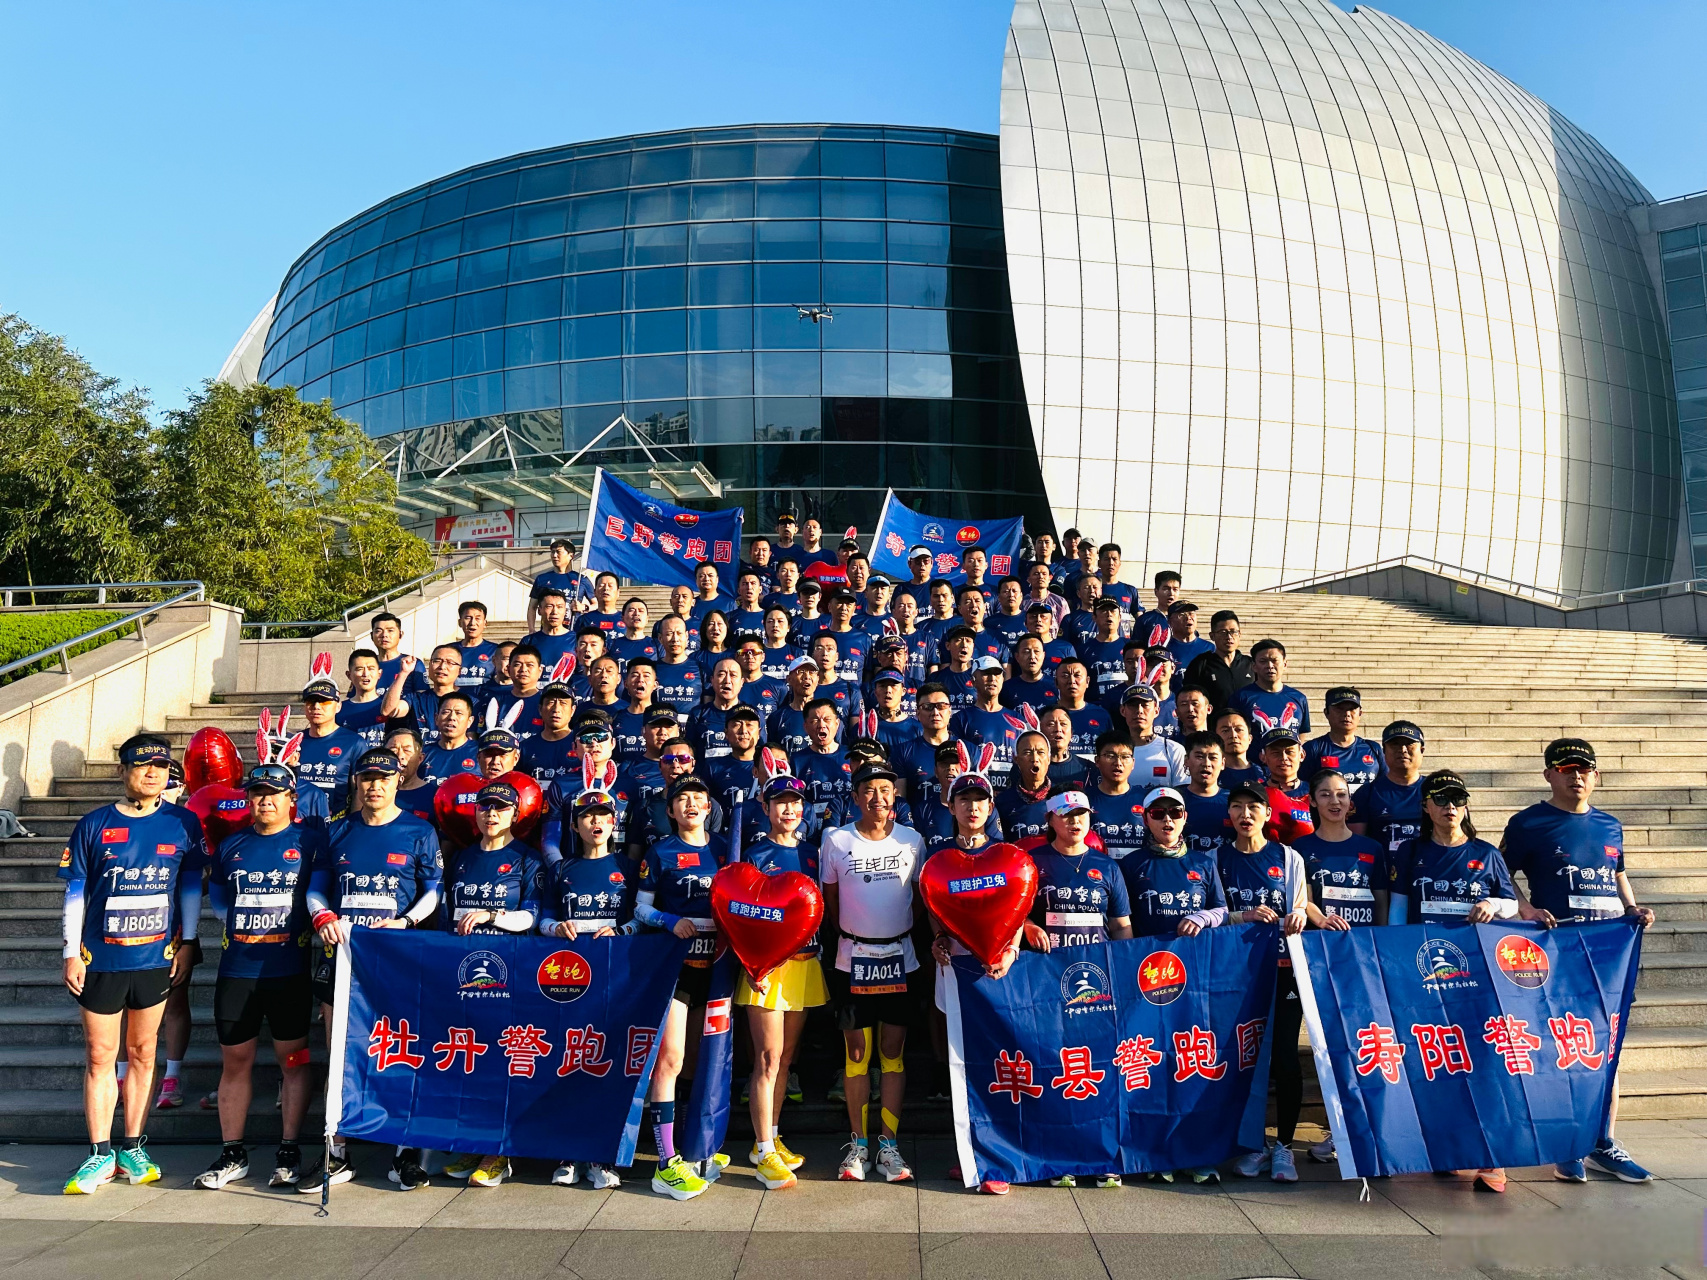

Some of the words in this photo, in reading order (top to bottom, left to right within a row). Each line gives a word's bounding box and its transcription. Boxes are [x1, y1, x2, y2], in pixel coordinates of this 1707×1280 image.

[605, 515, 732, 563] 巨野警跑团
[885, 531, 1012, 576] 菏警团
[218, 800, 246, 810] 4:30
[950, 875, 1006, 893] 警跑护卫兔
[730, 901, 783, 922] 警跑护卫兔
[108, 914, 163, 932] 警JB055
[235, 912, 287, 931] 警JB014
[854, 962, 901, 981] 警JA014
